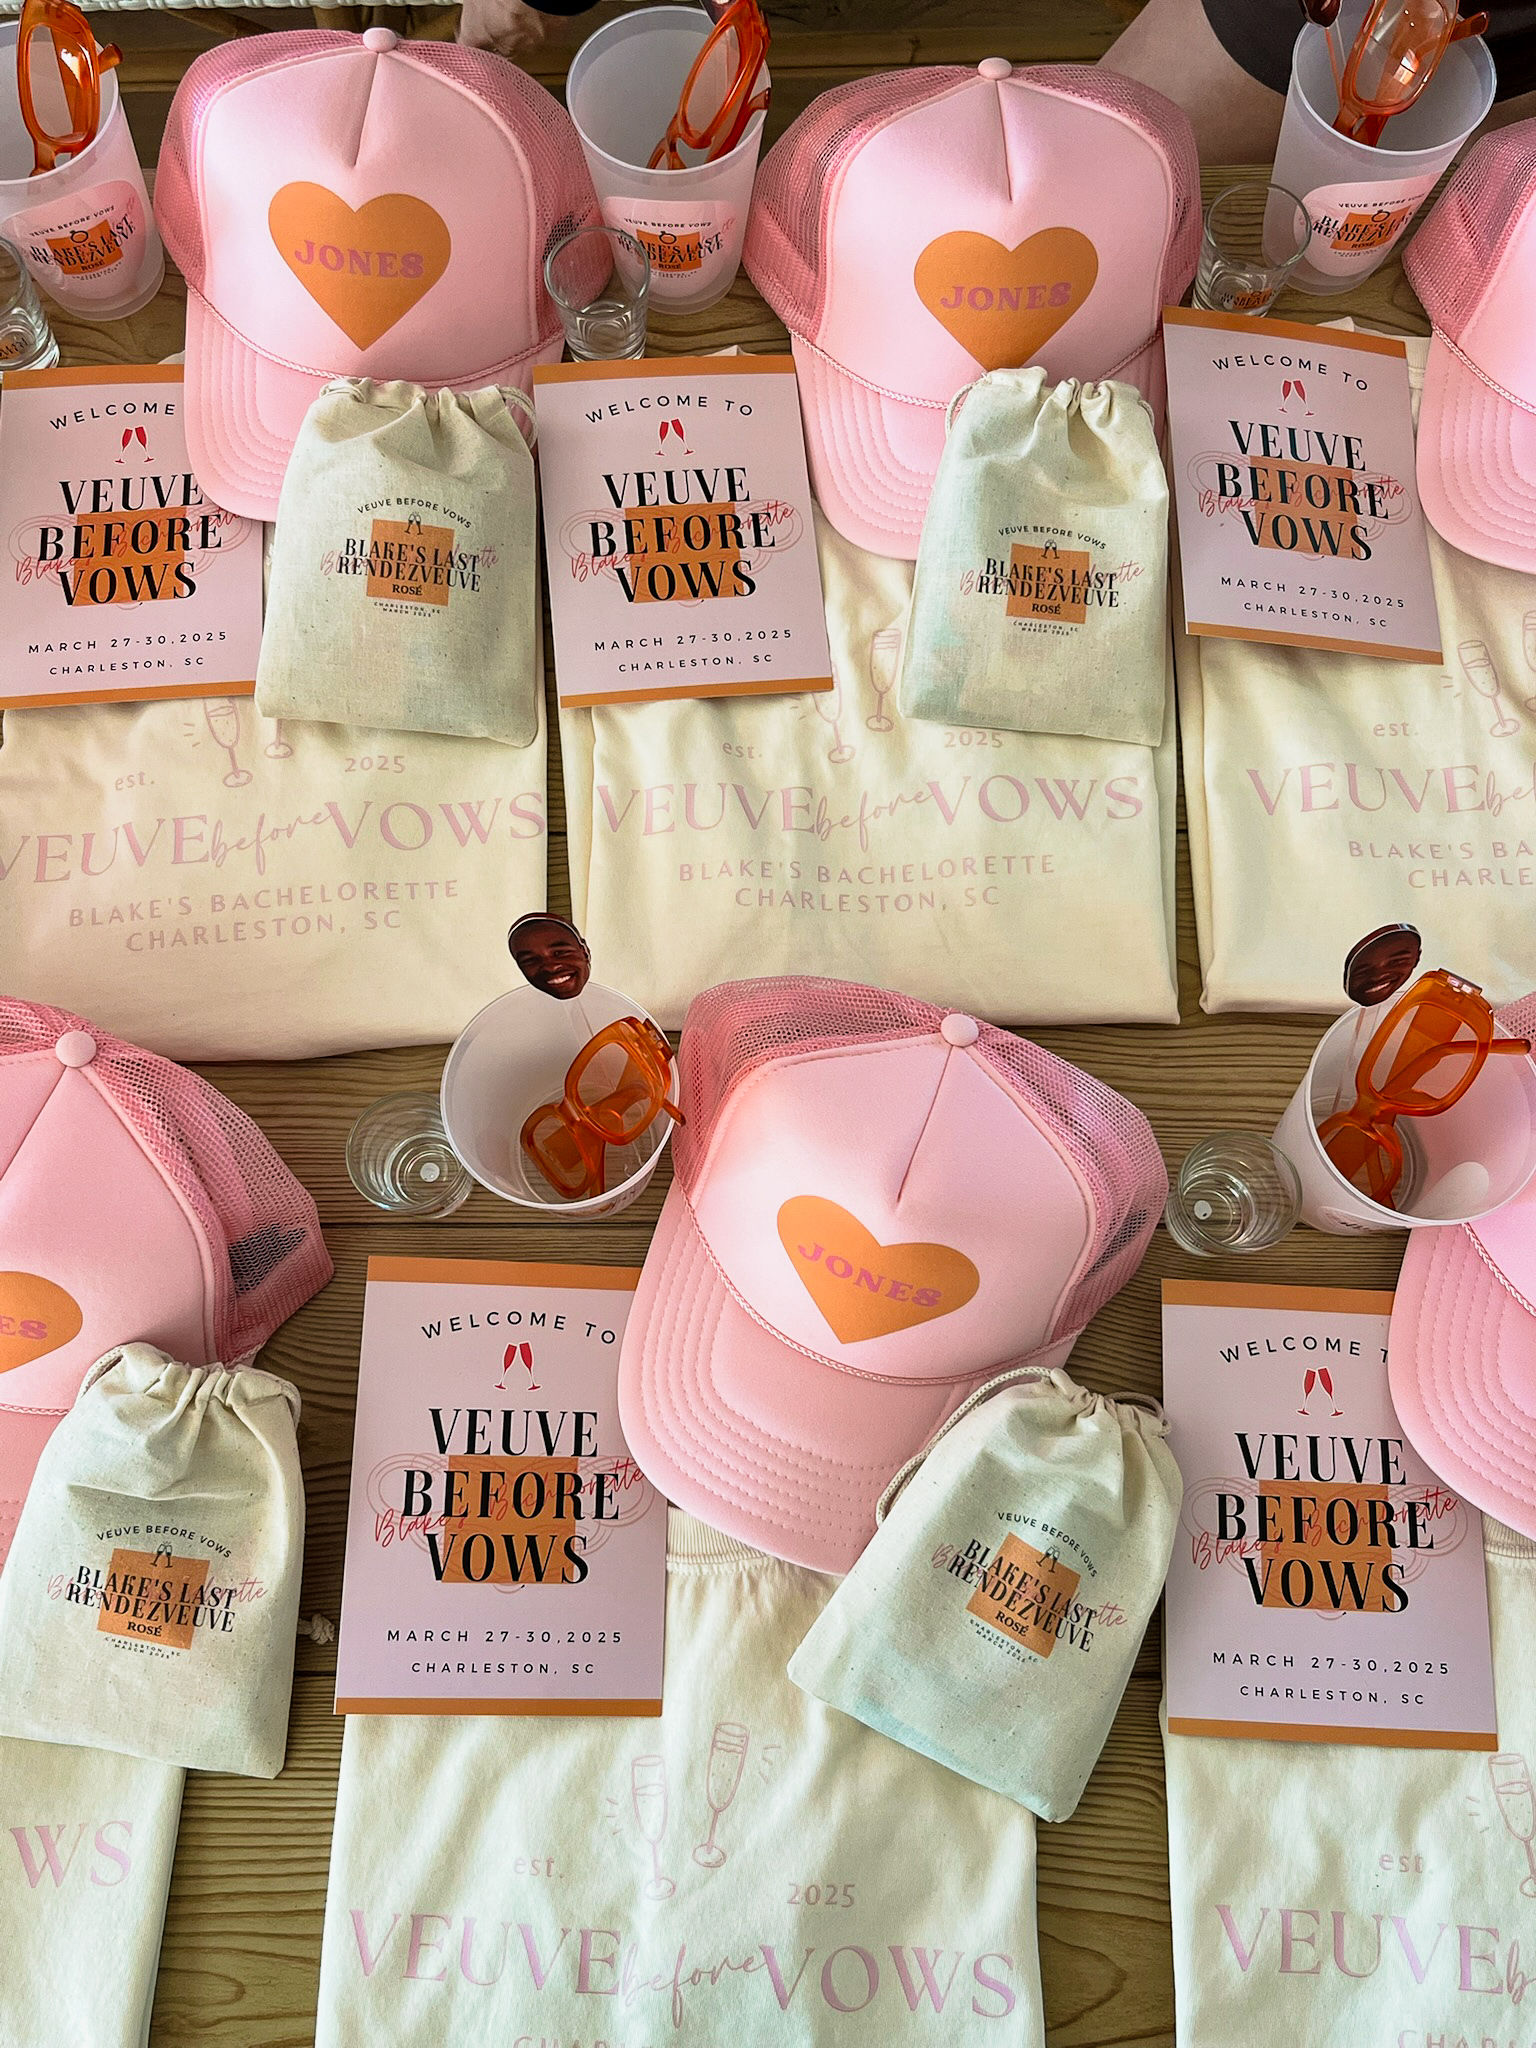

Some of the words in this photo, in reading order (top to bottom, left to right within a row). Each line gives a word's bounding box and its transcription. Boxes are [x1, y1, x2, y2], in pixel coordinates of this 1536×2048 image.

[293, 237, 426, 280] JONES
[939, 281, 1073, 312] JONES
[1212, 354, 1328, 376] WELCOME
[1342, 371, 1369, 391] TO
[49, 402, 177, 430] WELCOME
[585, 394, 708, 424] WELCOME
[724, 399, 754, 417] TO
[1227, 420, 1367, 472] VEUVE
[58, 473, 204, 515] VEUVE
[601, 466, 751, 509] VEUVE
[1215, 463, 1389, 519] BEFORE
[357, 498, 392, 514] VEUVE
[396, 497, 439, 512] BEFORE
[443, 507, 472, 529] VOWS
[37, 513, 223, 562] BEFORE
[588, 512, 777, 558] BEFORE
[998, 525, 1030, 536] VEUVE
[1032, 525, 1073, 538] BEFORE
[1077, 532, 1107, 550] VOWS
[1241, 510, 1372, 561] VOWS
[345, 538, 426, 565] BLAKE'S
[433, 550, 480, 573] LAST
[58, 561, 197, 606] VOWS
[338, 556, 481, 593] RENDEZVEUVE
[392, 583, 423, 596] ROSÉ
[613, 559, 757, 603] VOWS
[985, 557, 1064, 584] BLAKE'S
[1071, 568, 1117, 590] LAST
[1220, 576, 1287, 593] MARCH
[978, 575, 1120, 608] RENDEZVEUVE
[1031, 602, 1062, 615] ROSÉ
[1369, 617, 1388, 628] SC
[28, 639, 97, 654] MARCH
[594, 636, 664, 651] MARCH
[753, 653, 773, 663] SC
[184, 656, 205, 667] SC
[722, 740, 763, 761] est.
[944, 730, 1004, 750] 2025
[114, 769, 156, 791] est.
[344, 755, 407, 774] 2025
[1246, 761, 1486, 817] VEUVE
[597, 782, 817, 837] VEUVE
[816, 789, 929, 851] before
[927, 774, 1145, 827] VOWS
[211, 811, 331, 877] before
[325, 791, 546, 853] VOWS
[1348, 840, 1474, 860] BLAKE'S
[679, 860, 803, 883] BLAKE'S
[817, 854, 1056, 886] BACHELORETTE
[69, 896, 193, 928] BLAKE'S
[210, 879, 459, 913] BACHELORETTE
[735, 887, 948, 915] CHARLESTON,
[964, 886, 1001, 908] SC
[125, 914, 347, 952] CHARLESTON,
[363, 909, 401, 930] SC
[797, 1241, 943, 1308] JONES
[421, 1310, 567, 1340] WELCOME
[584, 1321, 617, 1345] TO
[1219, 1335, 1362, 1364] WELCOME
[428, 1407, 599, 1458] VEUVE
[1234, 1432, 1407, 1486] VEUVE
[401, 1469, 621, 1521] BEFORE
[1215, 1493, 1435, 1550] BEFORE
[96, 1525, 141, 1541] VEUVE
[145, 1524, 196, 1541] BEFORE
[199, 1535, 232, 1558] VOWS
[423, 1532, 590, 1585] VOWS
[996, 1511, 1036, 1528] VEUVE
[1041, 1523, 1081, 1551] BEFORE
[1080, 1550, 1098, 1578] VOWS
[76, 1565, 174, 1602] BLAKE'S
[180, 1583, 236, 1610] LAST
[962, 1538, 1051, 1604] BLAKE'S
[1050, 1591, 1098, 1630] LAST
[1242, 1557, 1410, 1614] VOWS
[66, 1583, 236, 1633] RENDEZVEUVE
[949, 1554, 1094, 1653] RENDEZVEUVE
[127, 1621, 162, 1637] ROSÉ
[387, 1629, 469, 1642] MARCH
[485, 1630, 621, 1644] 27-30,2025
[995, 1610, 1030, 1637] ROSÉ
[411, 1662, 557, 1675] CHARLESTON,
[571, 1663, 595, 1674] SC
[1212, 1652, 1294, 1667] MARCH
[1401, 1693, 1424, 1704] SC
[787, 1882, 856, 1909] 2025
[1215, 1904, 1503, 1994] VEUVE
[349, 1909, 622, 1996] VEUVE
[620, 1943, 762, 2029] before
[759, 1942, 1017, 2019] VOWS
